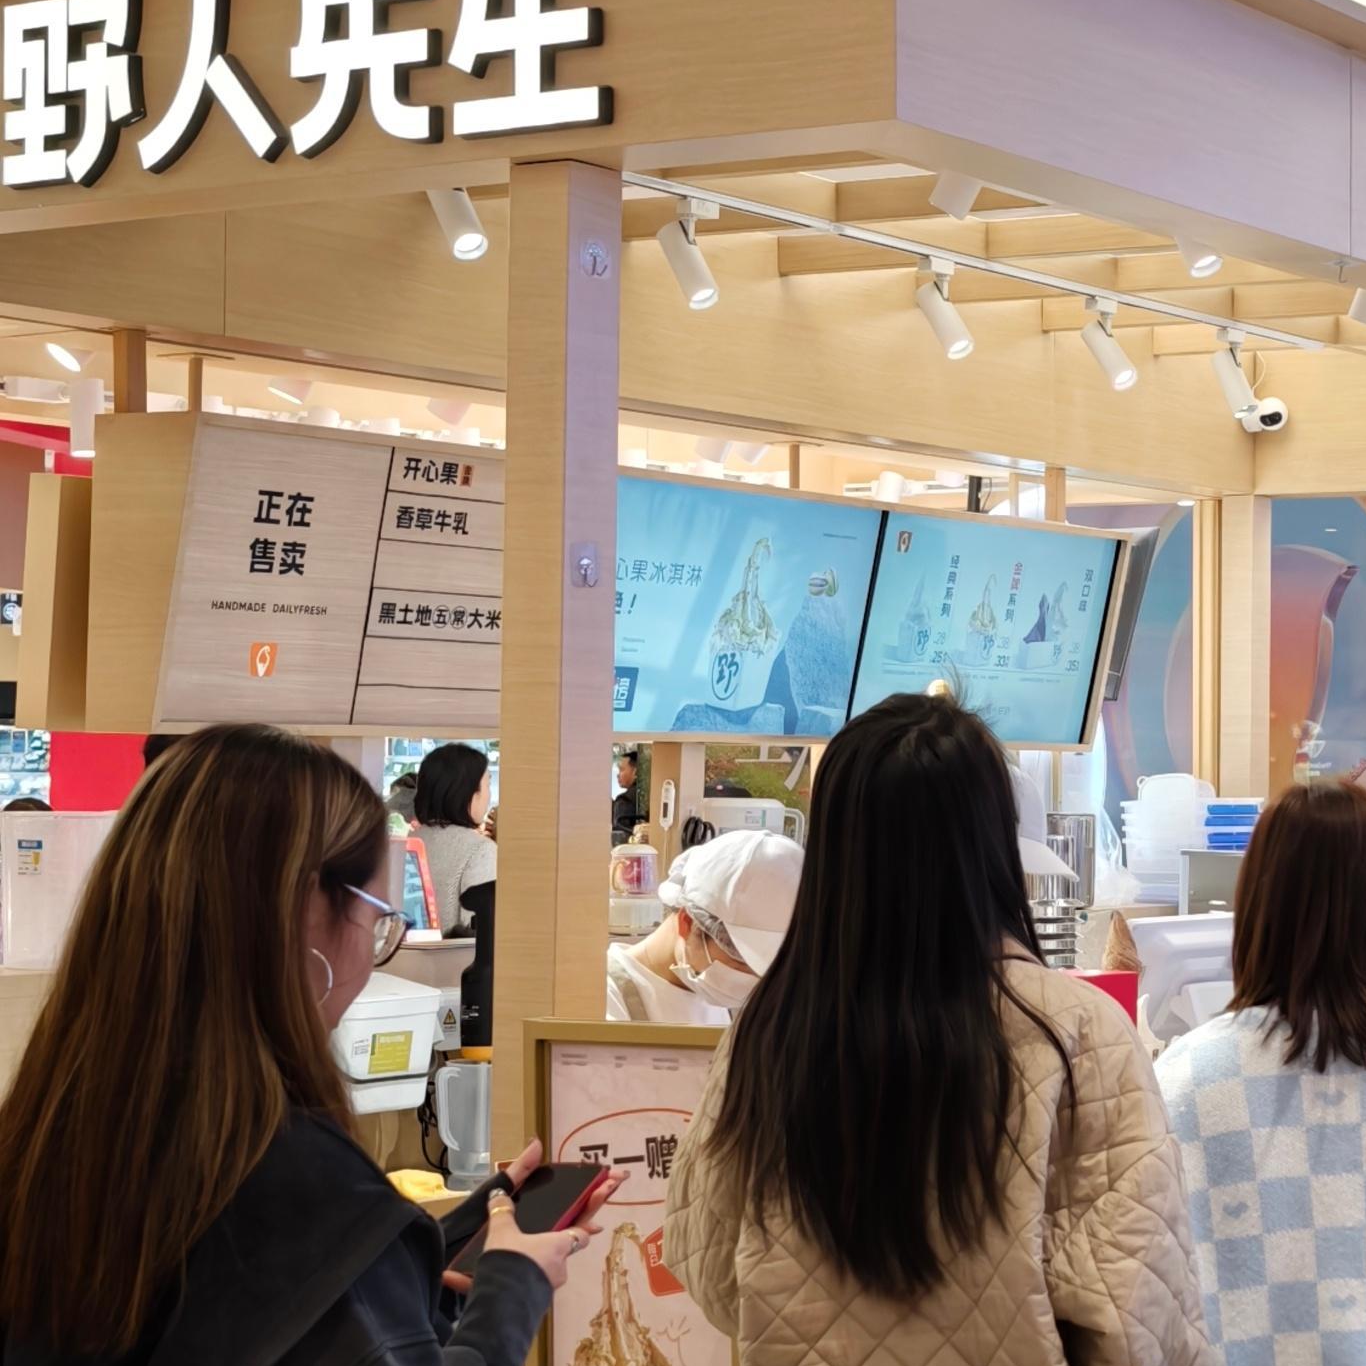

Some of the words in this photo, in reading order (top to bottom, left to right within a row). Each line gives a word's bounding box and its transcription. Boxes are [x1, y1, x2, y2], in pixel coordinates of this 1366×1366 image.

[403, 457, 459, 485] 开心果
[253, 490, 315, 527] 正在
[396, 506, 469, 535] 香草牛乳
[249, 538, 307, 575] 售卖
[211, 600, 267, 613] HANDMADE
[272, 603, 327, 616] DAILYFRESH
[378, 602, 502, 631] 黑土地五常大米
[716, 652, 739, 694] 野
